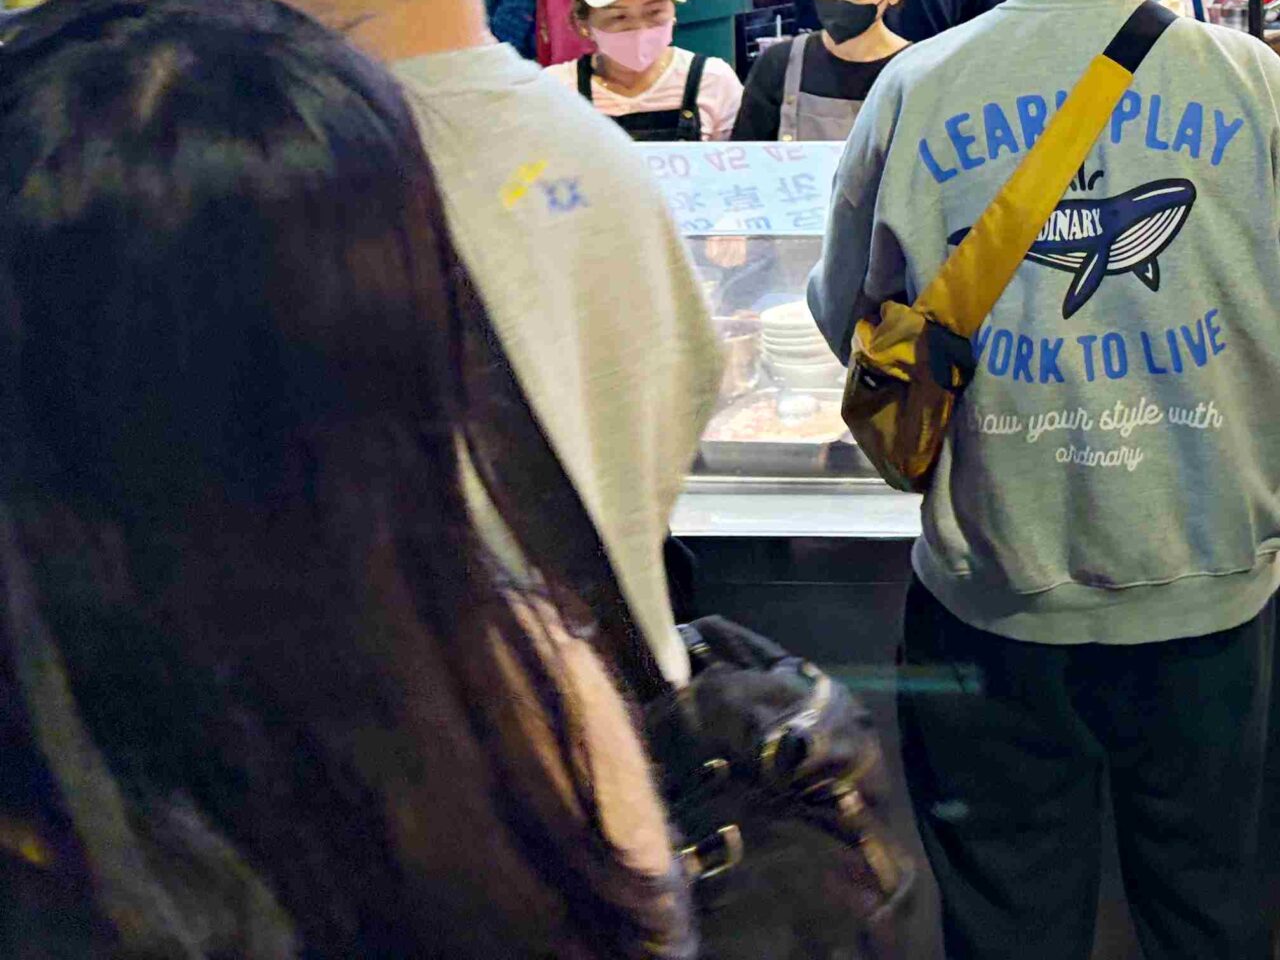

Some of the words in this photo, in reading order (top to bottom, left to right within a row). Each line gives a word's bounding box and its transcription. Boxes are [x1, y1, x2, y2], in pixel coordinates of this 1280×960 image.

[1110, 89, 1244, 167] PLAY
[1077, 332, 1128, 382] TO
[1140, 308, 1226, 374] LIVE
[1027, 407, 1094, 443] your
[1099, 396, 1164, 437] style
[1168, 401, 1223, 429] with
[1055, 444, 1144, 471] ordinary
